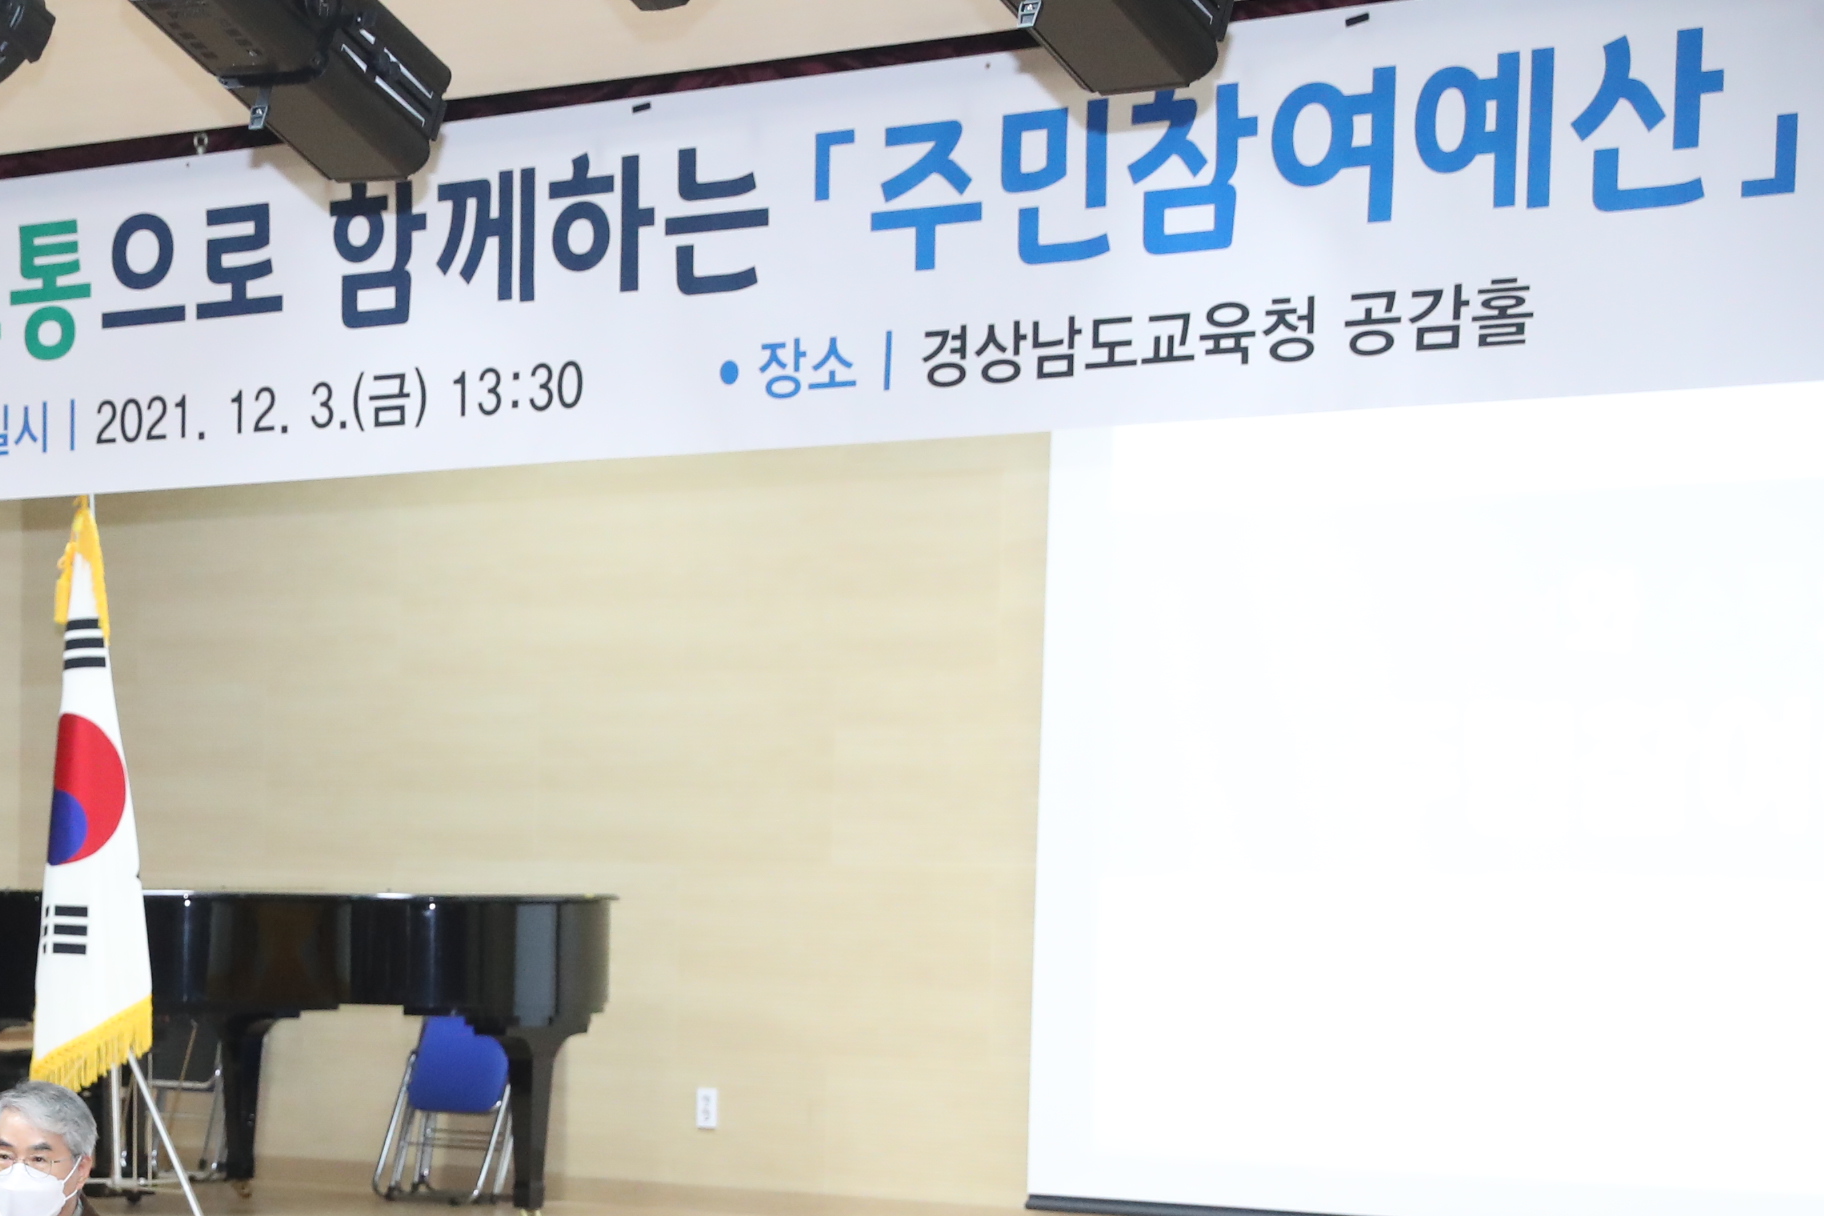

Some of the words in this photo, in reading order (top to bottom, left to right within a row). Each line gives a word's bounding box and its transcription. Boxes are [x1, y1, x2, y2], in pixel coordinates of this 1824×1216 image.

[330, 147, 770, 330] 함께하는
[758, 336, 858, 400] 장소
[921, 295, 1316, 388] 경상남도교육청
[1344, 277, 1536, 357] 공감홀
[95, 394, 206, 445] 2021.
[230, 387, 289, 434] 12.
[452, 360, 584, 417] 13:30
